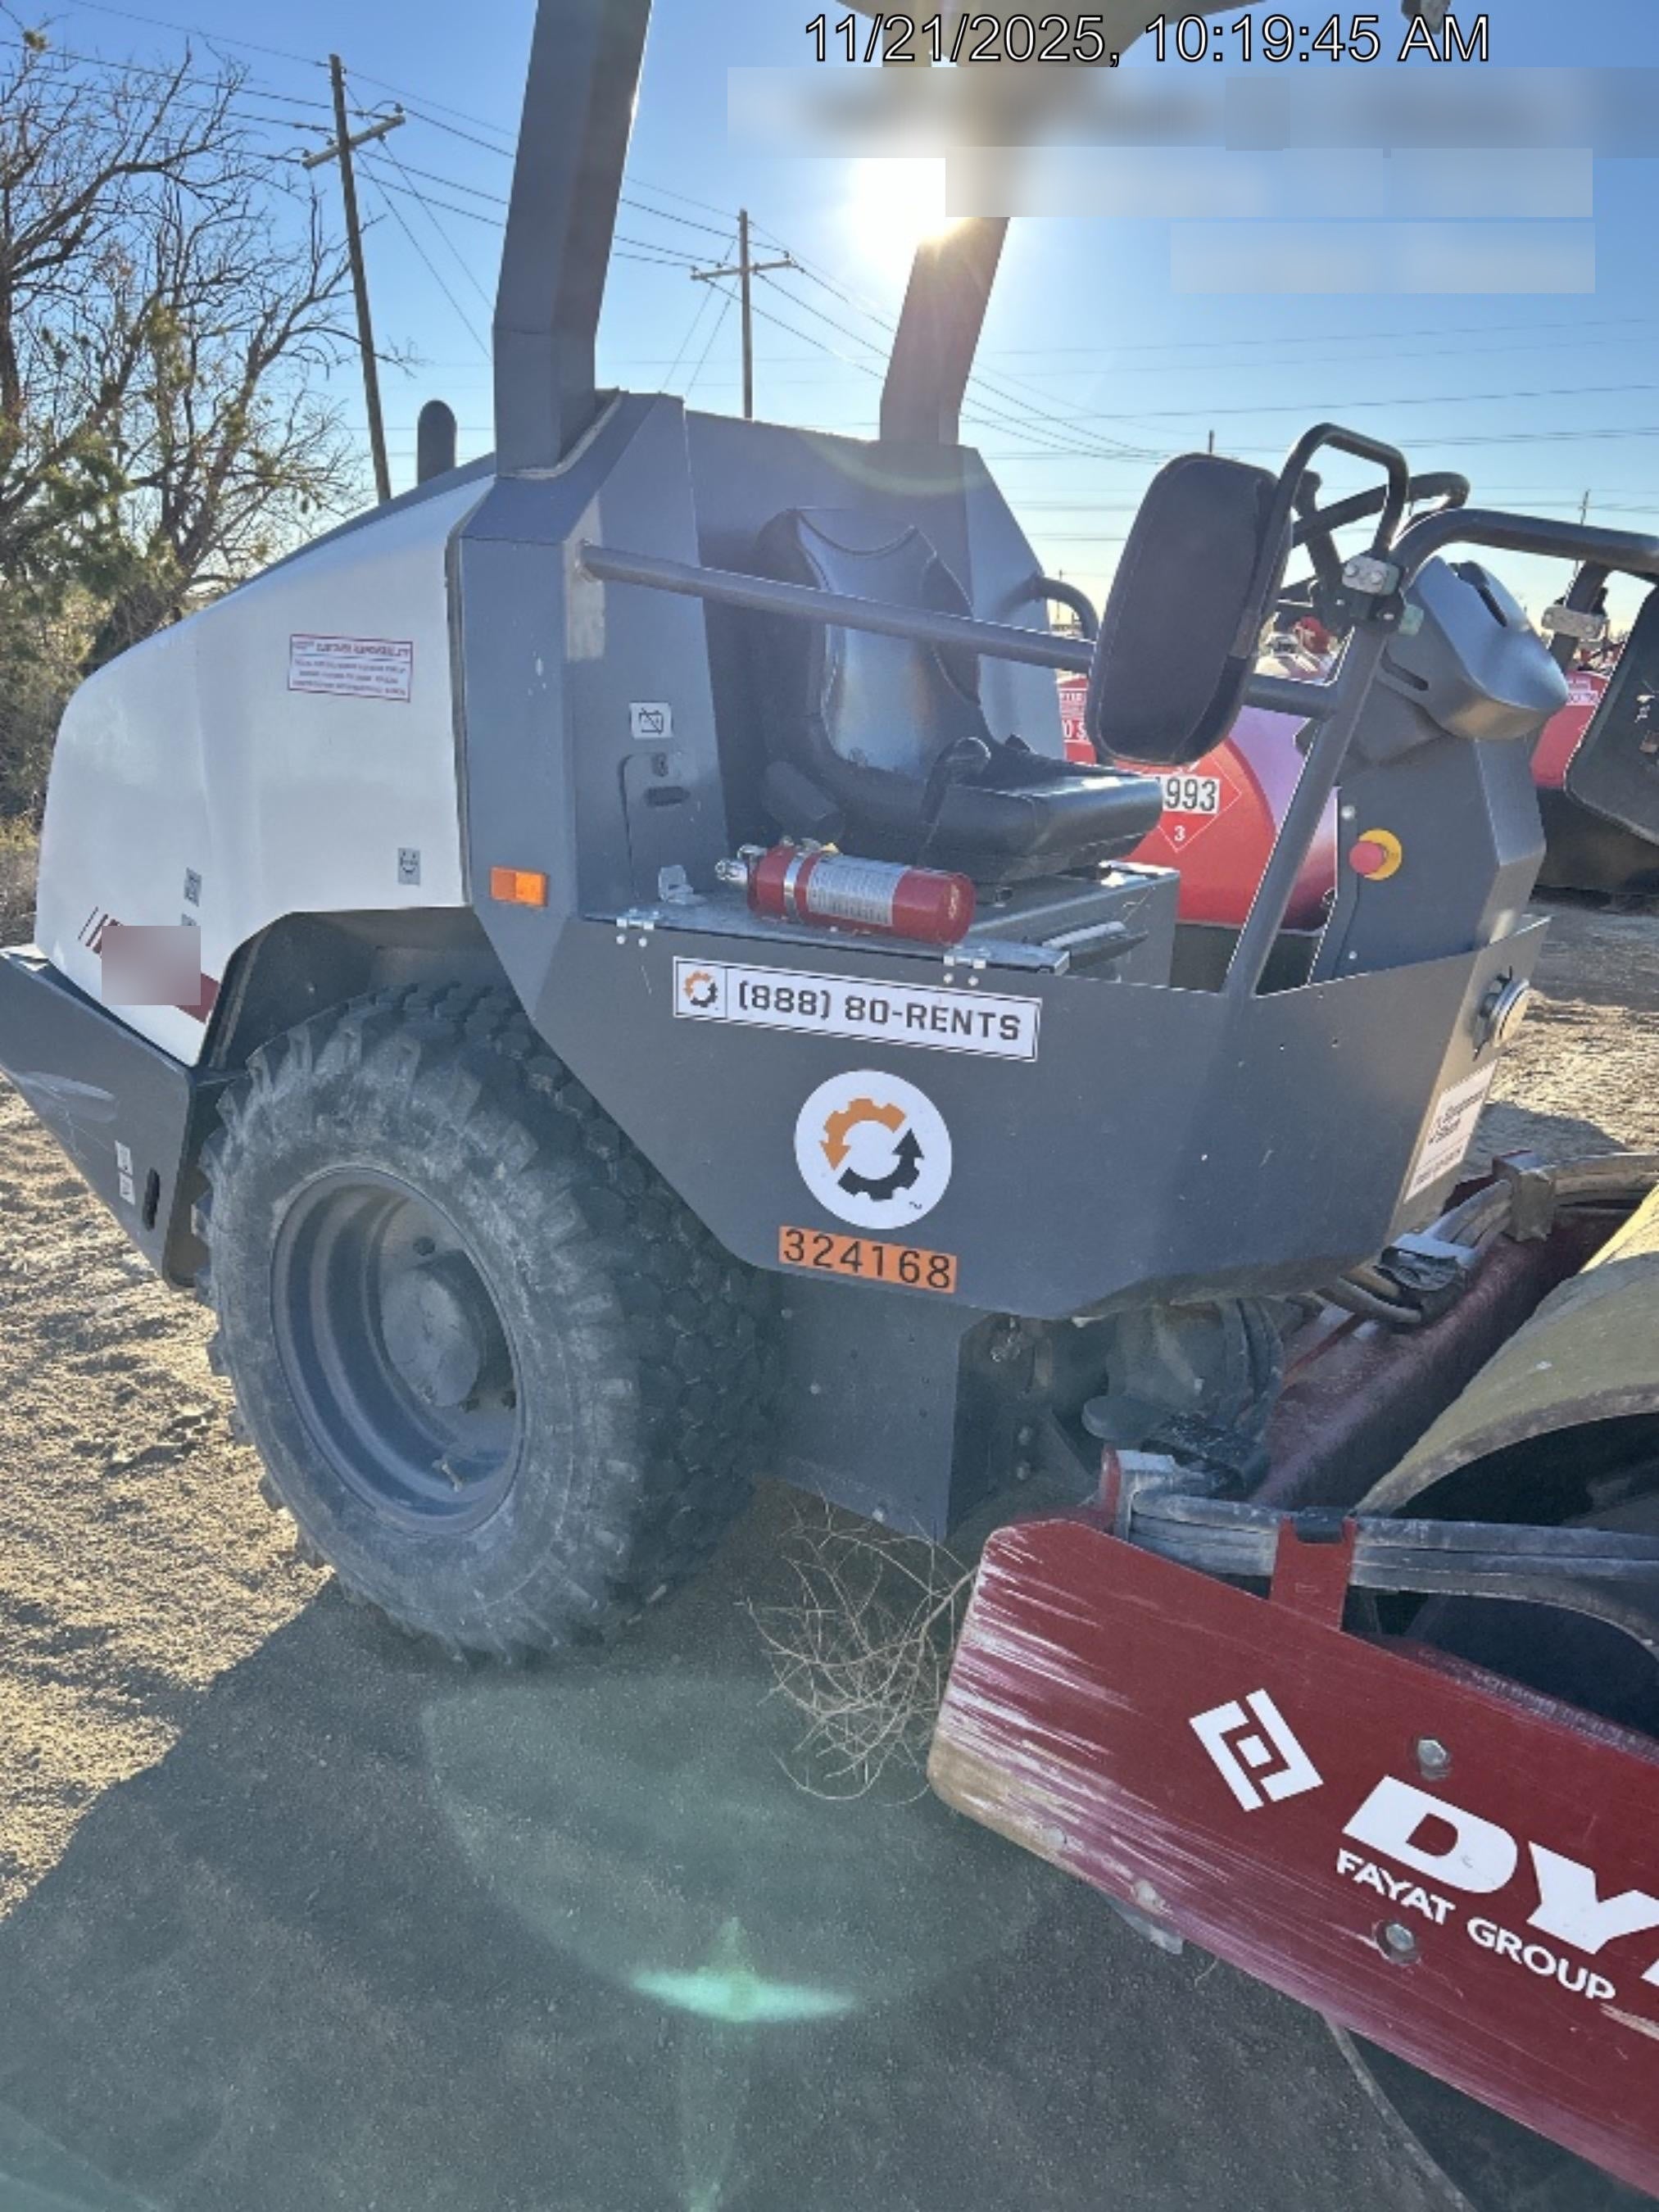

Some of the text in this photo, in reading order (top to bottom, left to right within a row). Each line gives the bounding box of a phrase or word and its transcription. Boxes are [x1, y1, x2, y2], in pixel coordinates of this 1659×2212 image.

[1156, 776, 1217, 811] 993
[1174, 825, 1185, 841] 3
[738, 980, 1022, 1041] (888) 80-RENTS
[783, 1228, 950, 1290] 324168
[1341, 1775, 1659, 1988] DY
[1335, 1848, 1616, 2001] FAYAT GROUP
